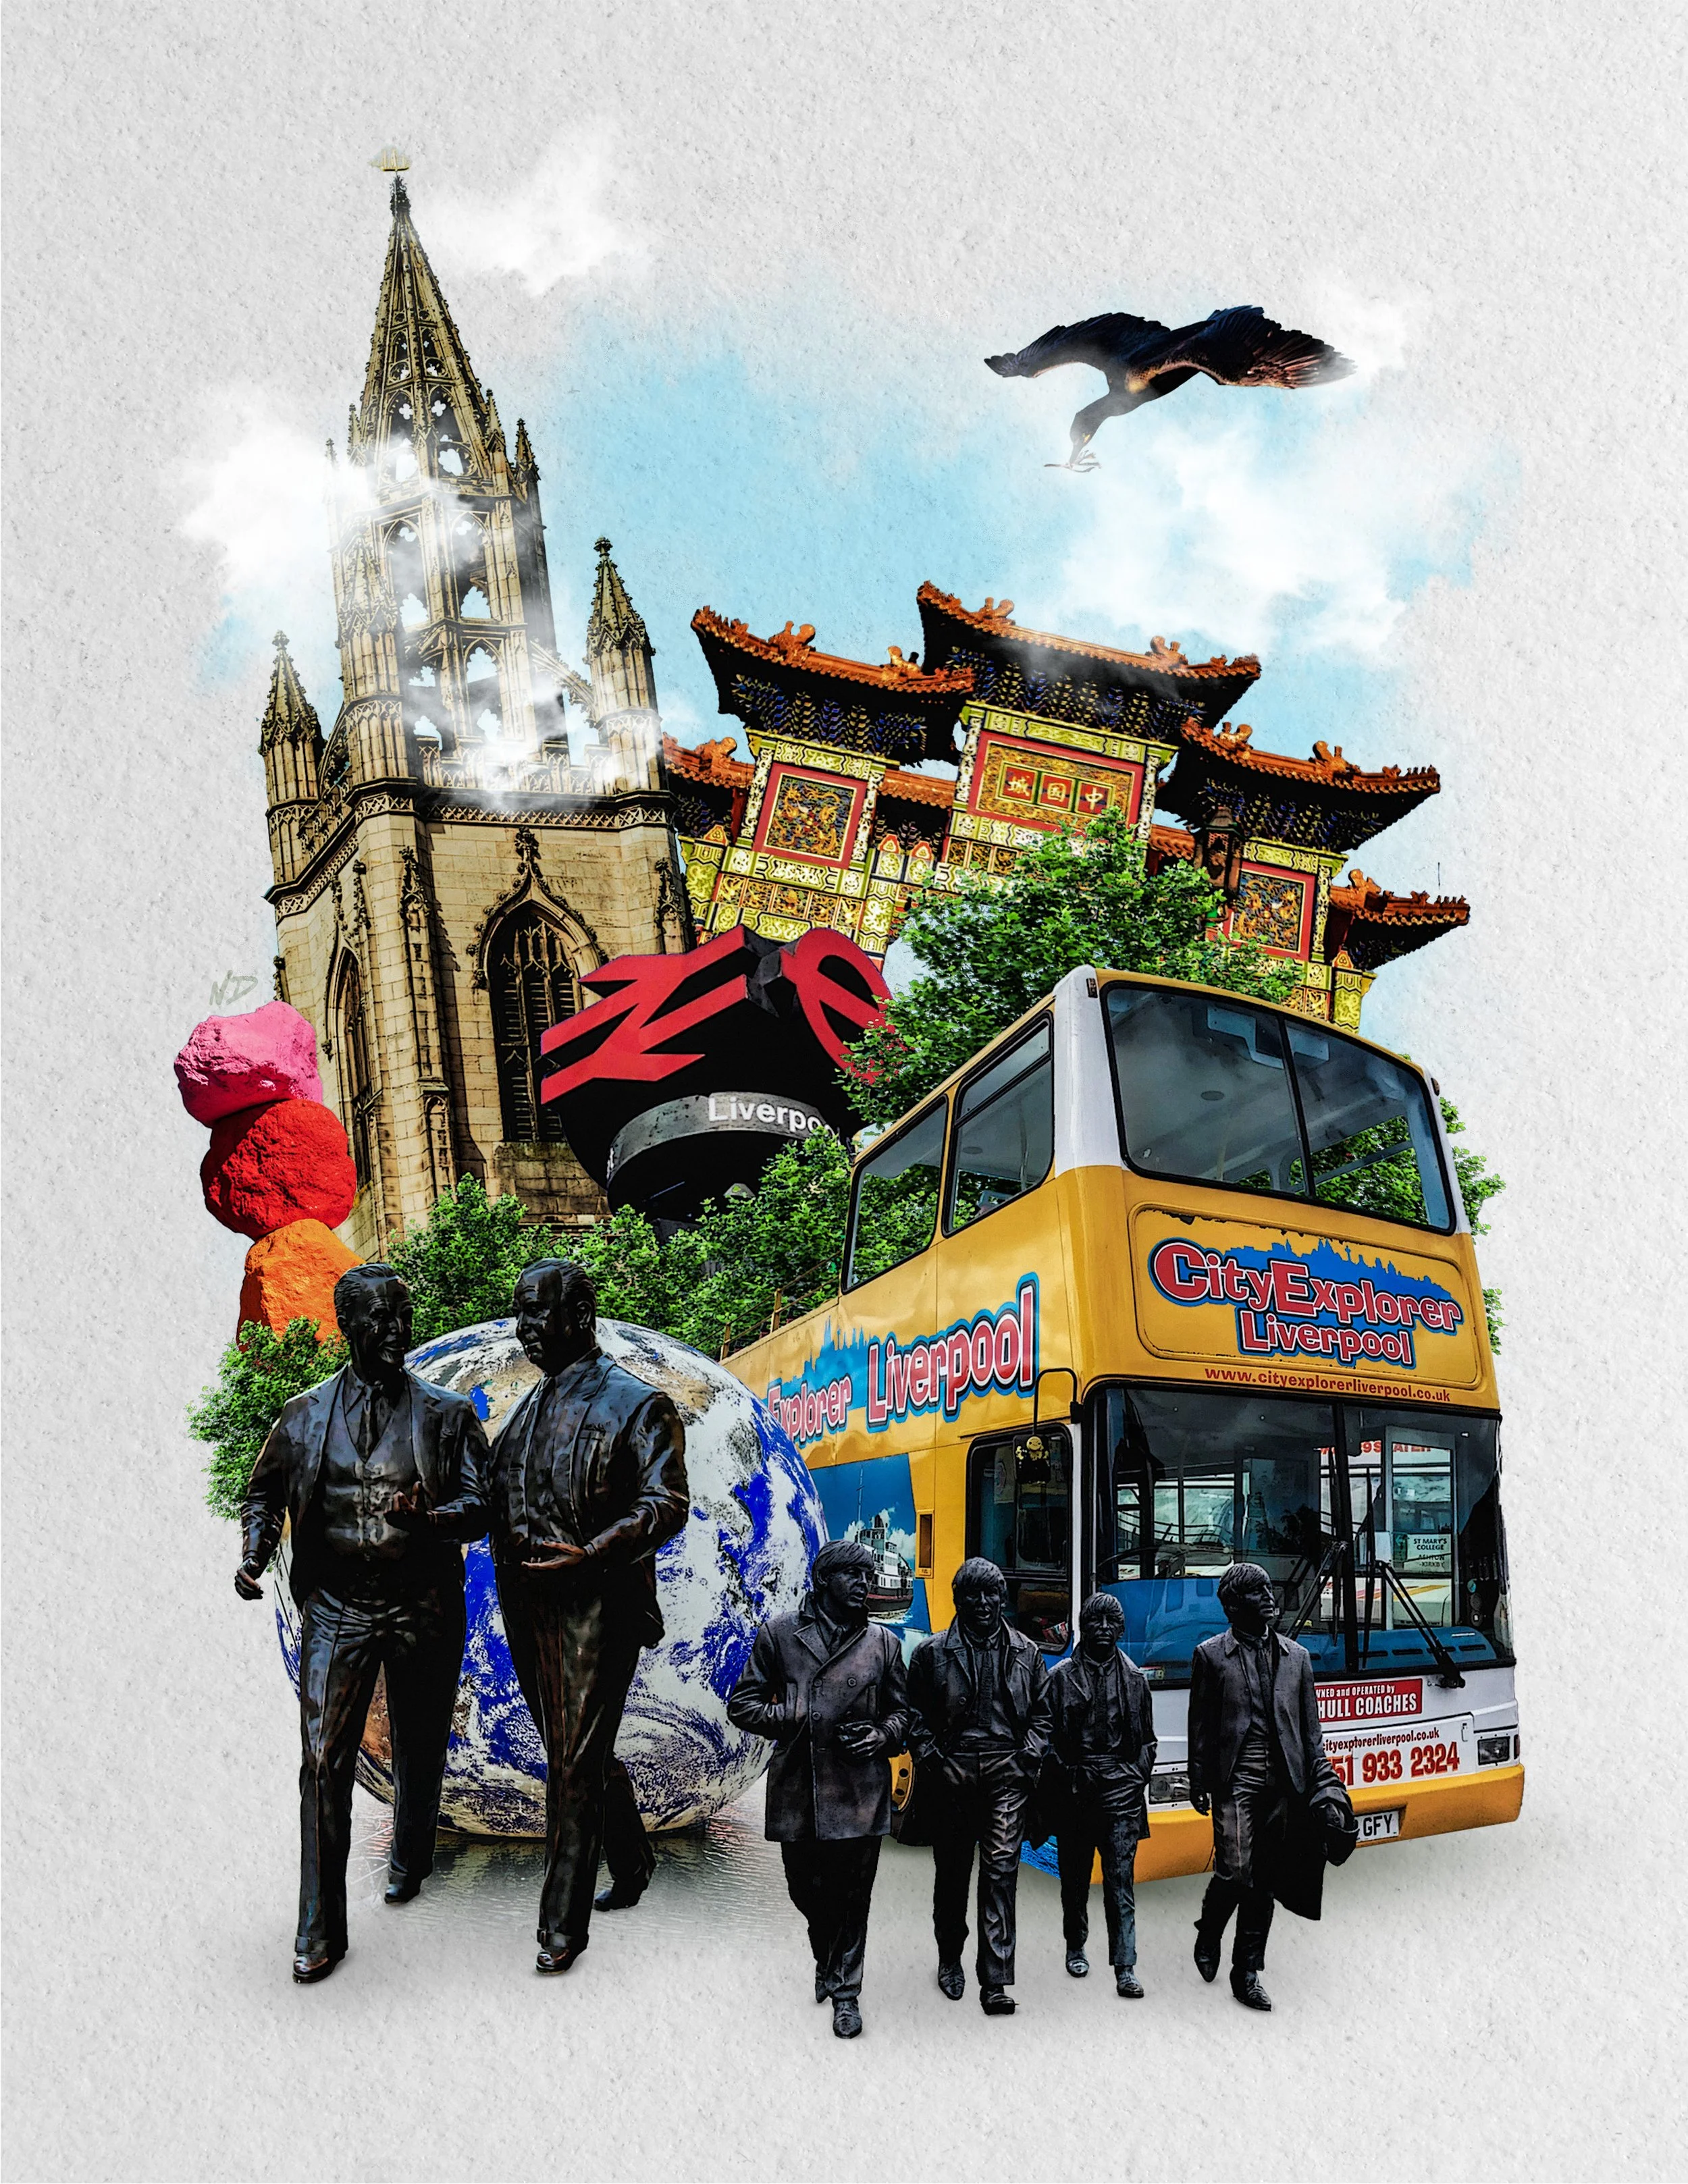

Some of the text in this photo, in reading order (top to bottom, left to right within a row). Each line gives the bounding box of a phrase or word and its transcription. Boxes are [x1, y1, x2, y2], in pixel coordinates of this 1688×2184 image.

[708, 1096, 842, 1147] Liverpo
[1240, 1311, 1413, 1364] Liverpool
[768, 1285, 1034, 1442] Explorer Liverpool
[1205, 1368, 1451, 1402] www.cityexplorerliverpool.co.uk
[1336, 1687, 1350, 1697] and
[1352, 1685, 1385, 1696] OPERATED
[1386, 1684, 1395, 1694] by
[1356, 1694, 1417, 1716] COACHES
[1362, 1749, 1402, 1783] 933
[1410, 1741, 1460, 1778] 2324
